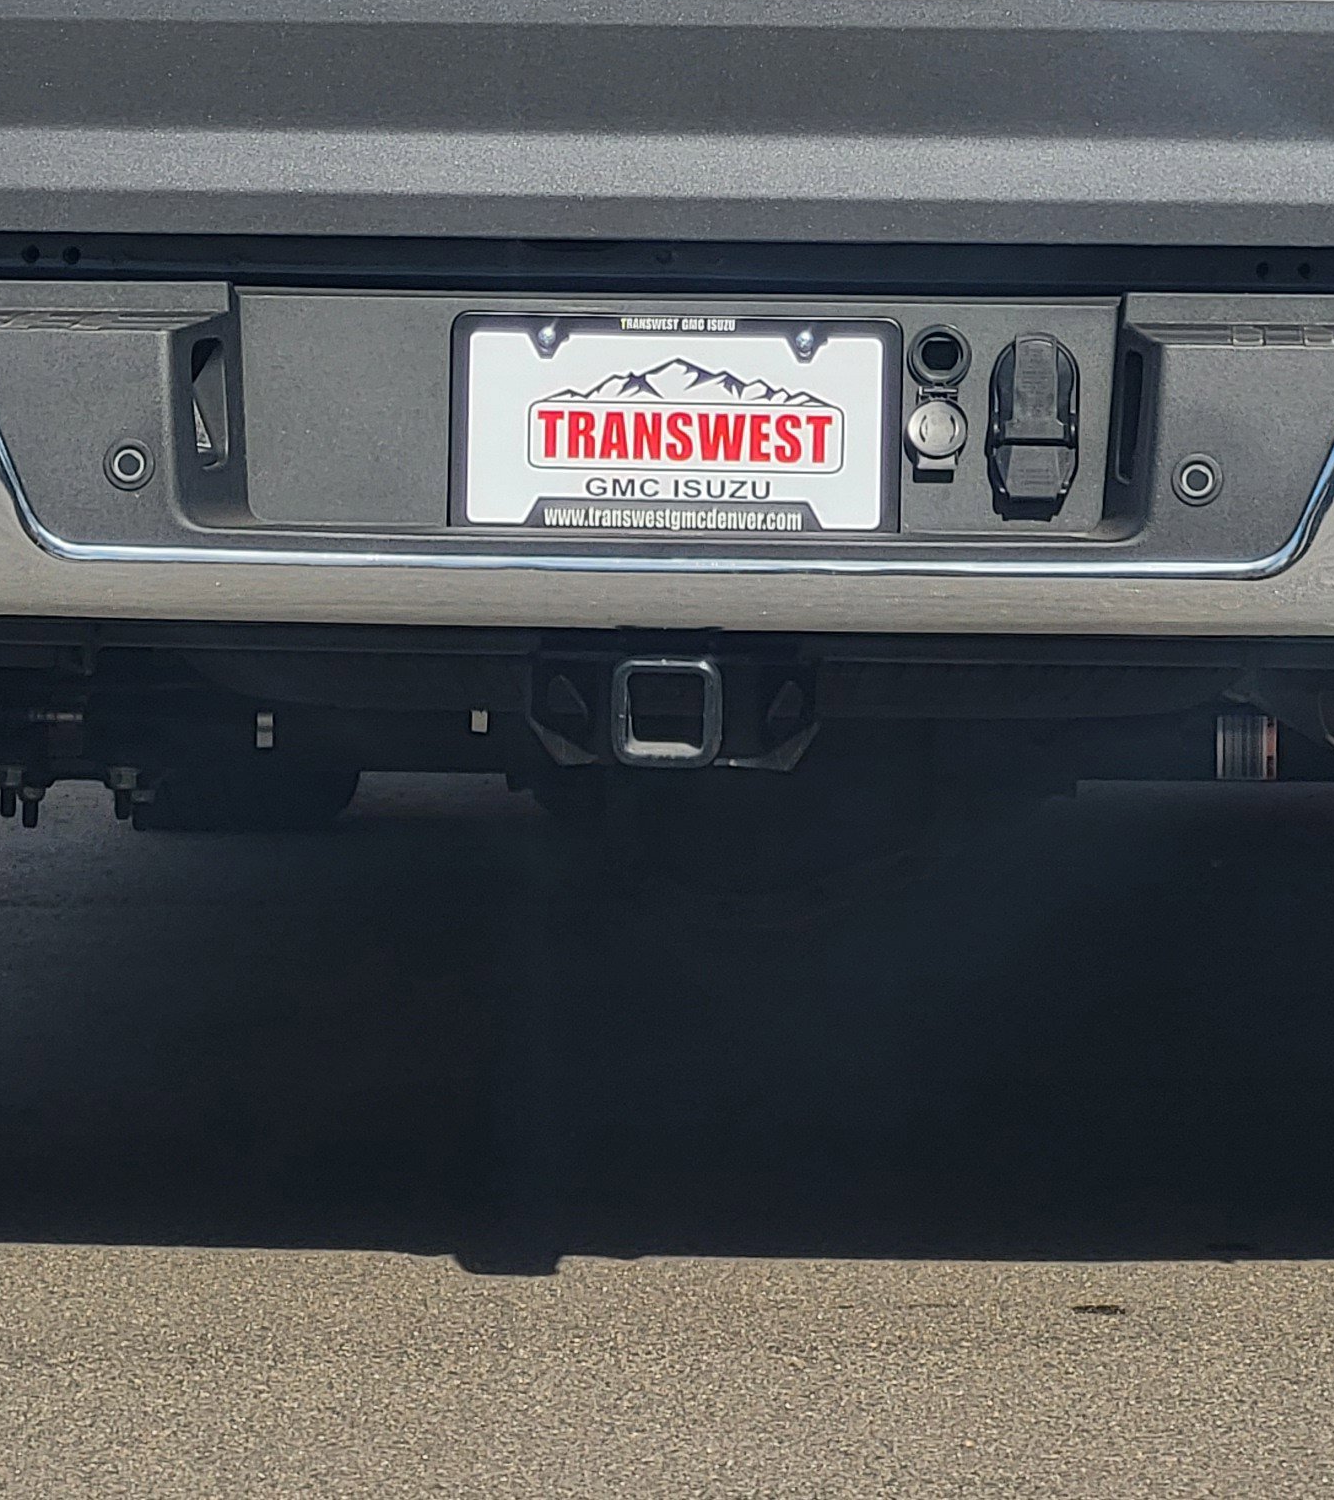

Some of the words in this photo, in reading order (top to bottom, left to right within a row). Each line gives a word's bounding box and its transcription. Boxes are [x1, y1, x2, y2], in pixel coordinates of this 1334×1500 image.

[620, 317, 679, 331] TRANSWEST
[537, 409, 833, 464] TRANSWEST
[585, 476, 660, 498] GMC
[673, 478, 771, 500] ISUZU
[543, 504, 802, 532] www.transwestgmcdenver.com
